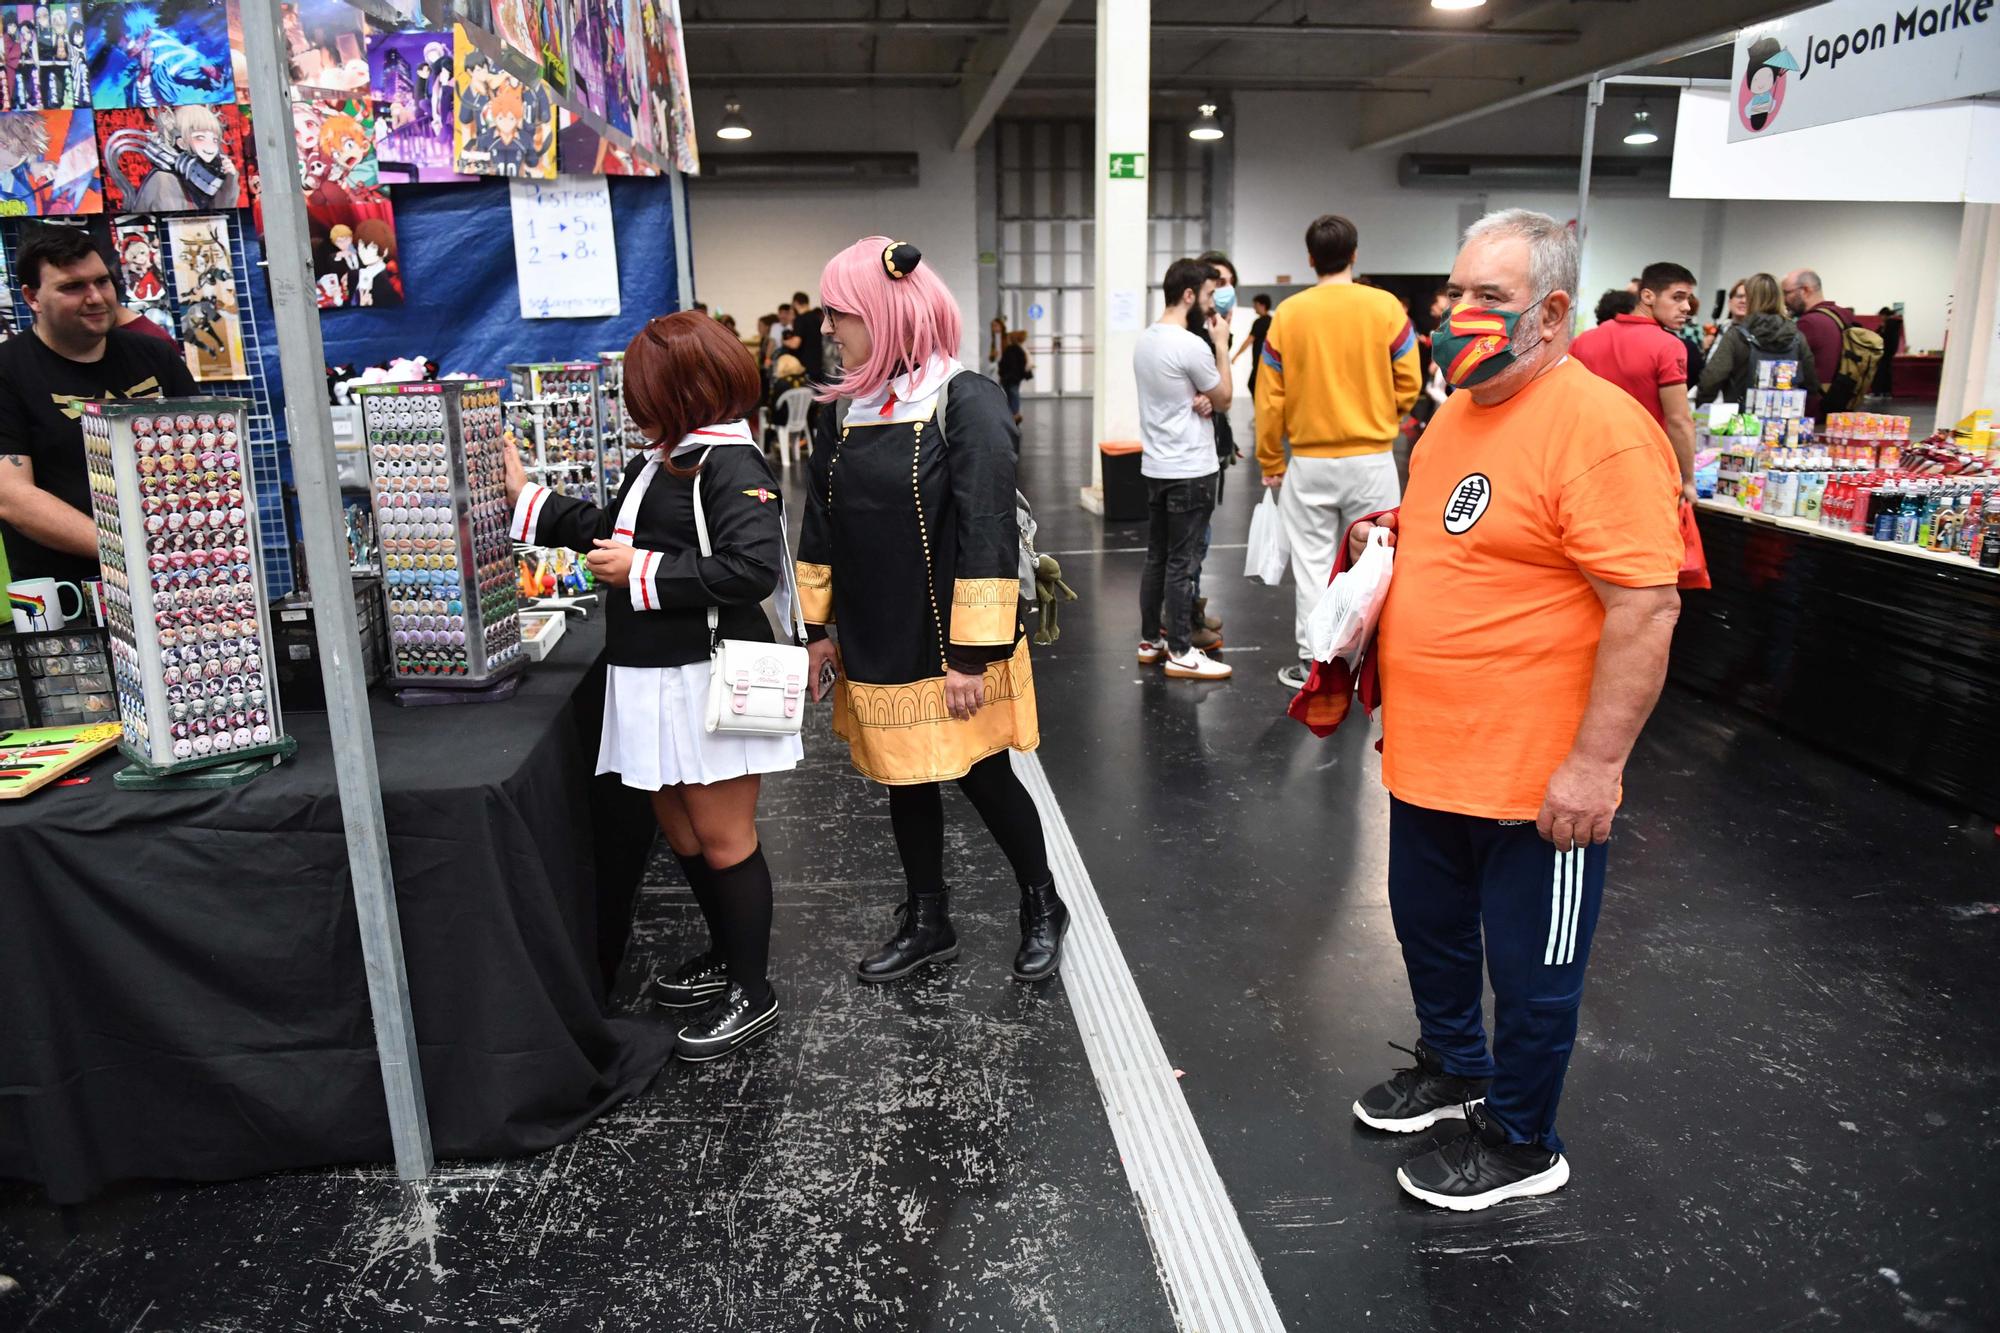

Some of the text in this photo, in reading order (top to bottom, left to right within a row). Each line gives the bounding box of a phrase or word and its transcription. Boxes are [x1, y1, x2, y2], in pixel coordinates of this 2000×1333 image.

[1799, 0, 1994, 81] Japon Marke
[528, 218, 536, 239] 1
[528, 246, 542, 264] 2
